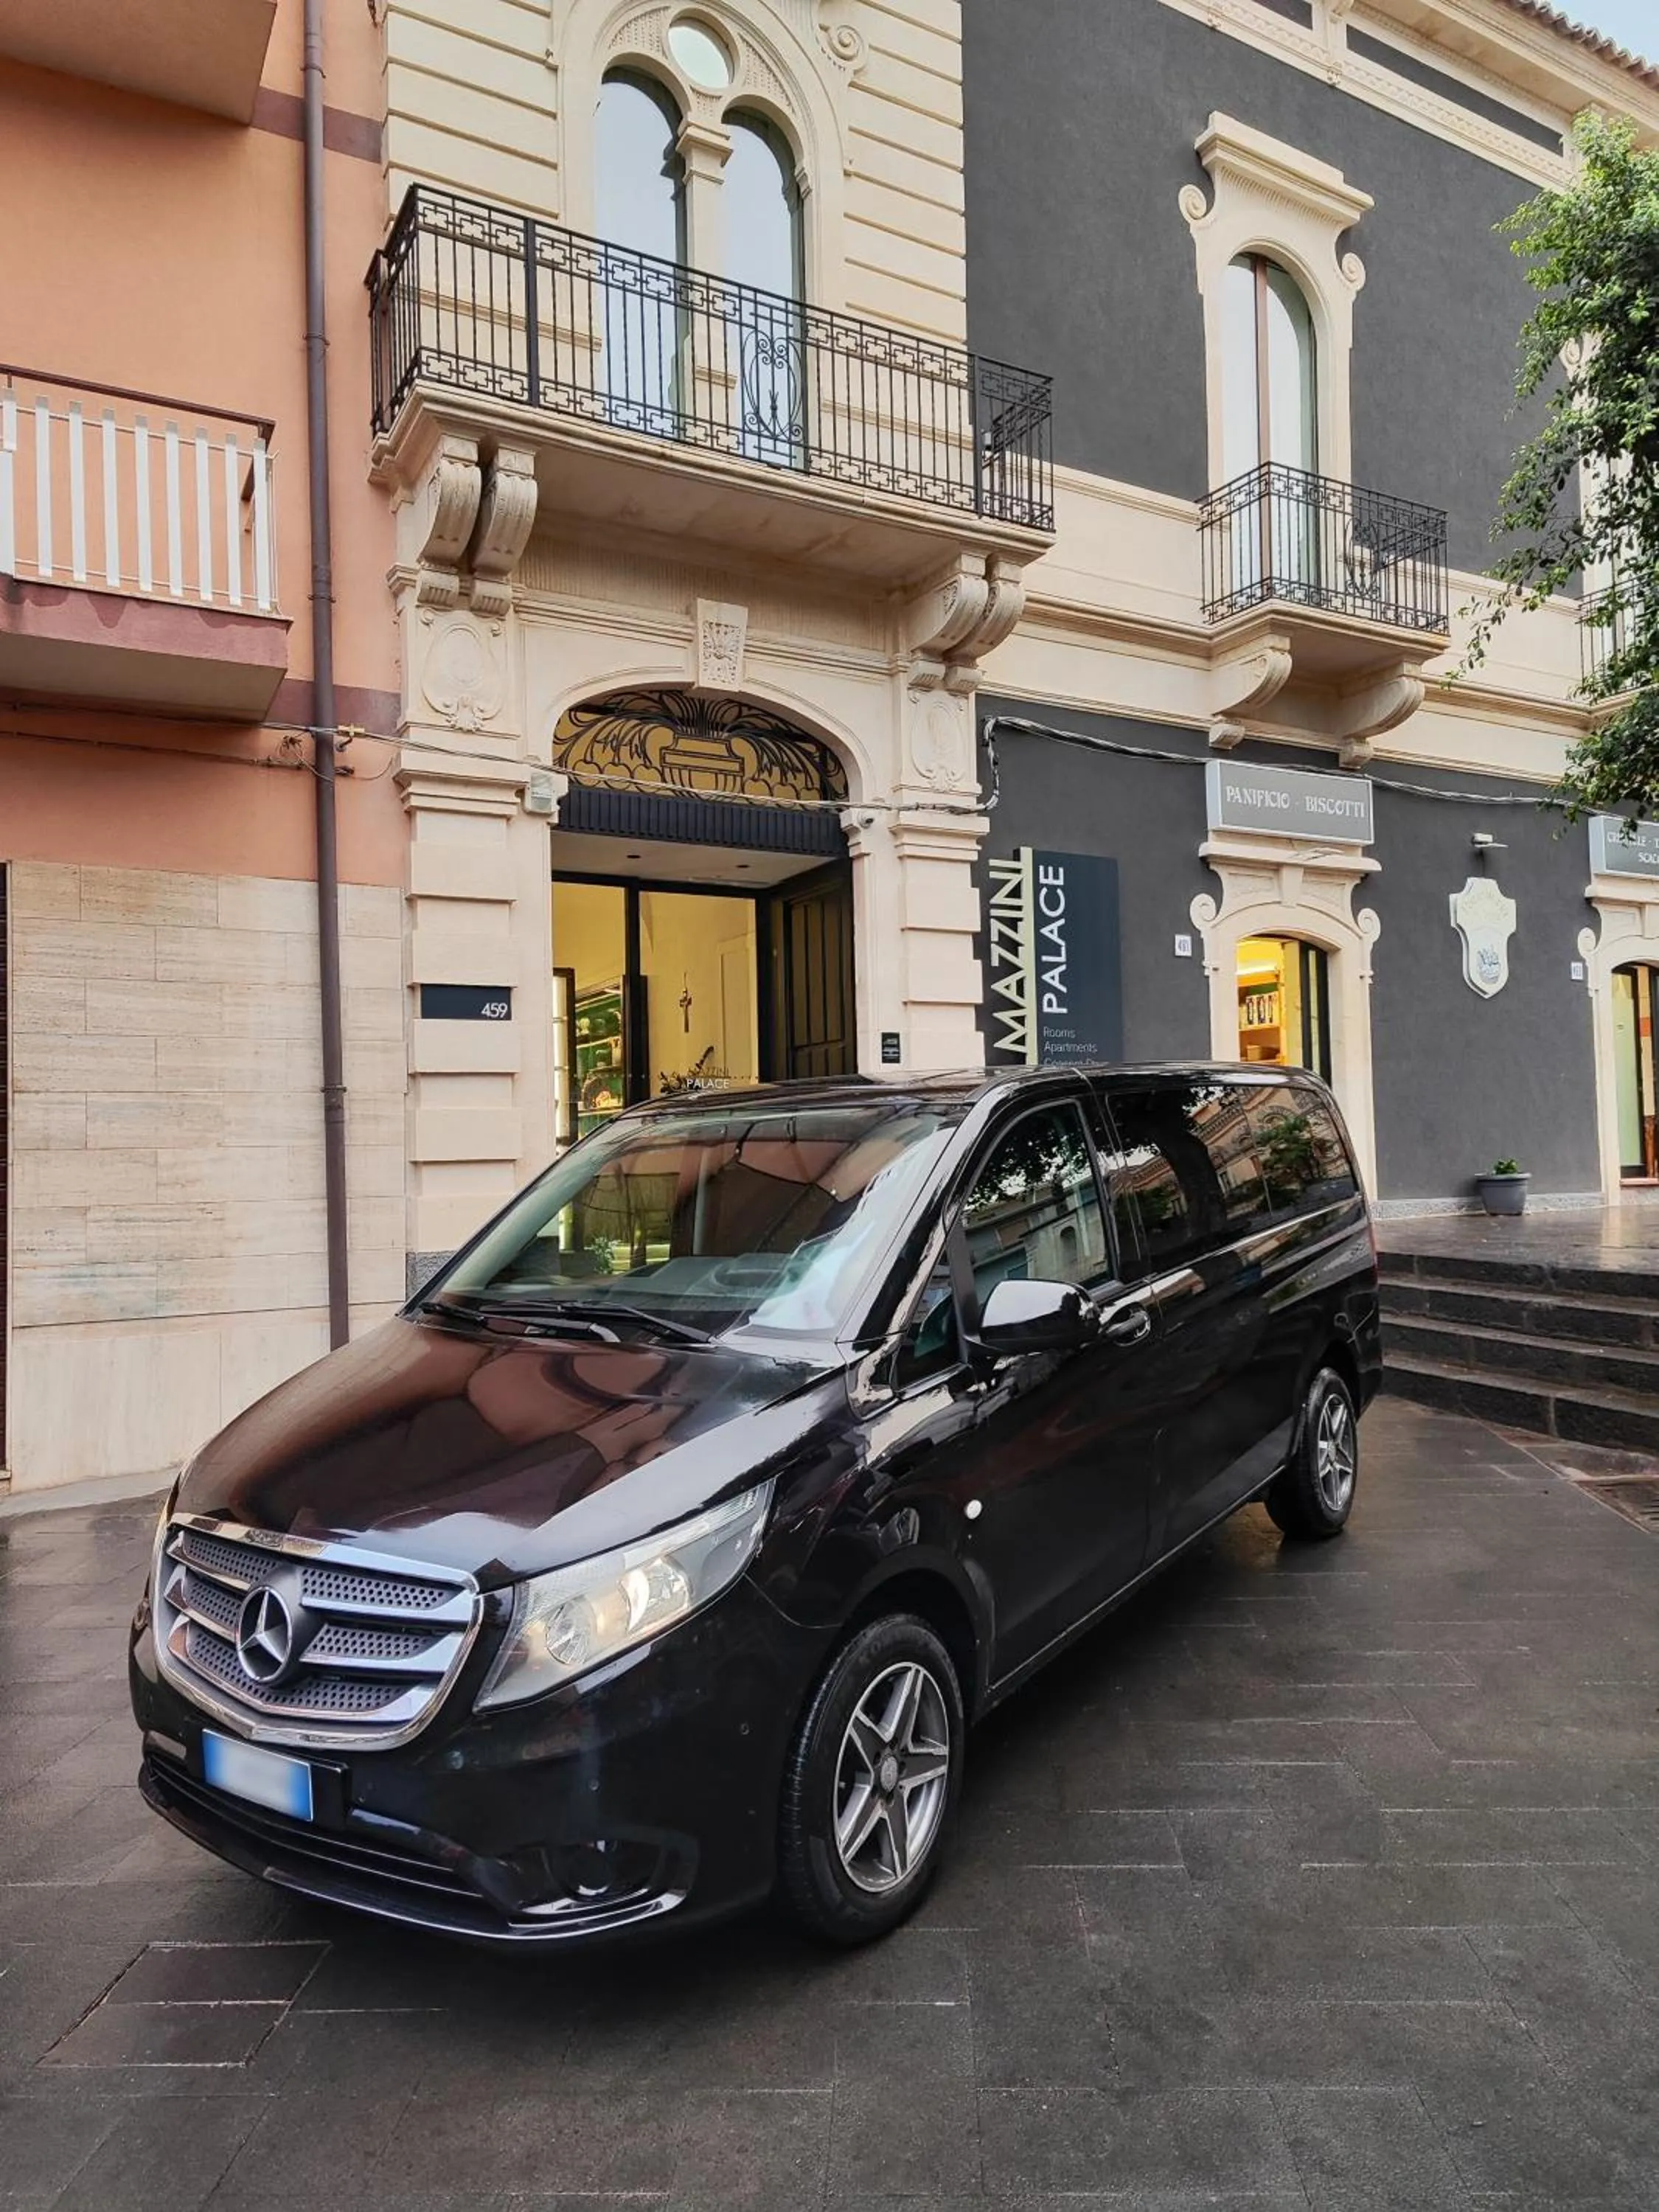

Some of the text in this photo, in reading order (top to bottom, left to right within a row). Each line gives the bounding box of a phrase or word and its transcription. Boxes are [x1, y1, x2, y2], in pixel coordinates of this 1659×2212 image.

[1225, 785, 1290, 809] PANIFICIO
[1305, 796, 1365, 818] BISCOTTI
[1039, 865, 1068, 1014] PALACE
[989, 856, 1029, 1057] MAZZINI
[481, 1002, 508, 1018] 459
[1043, 1026, 1077, 1039] Rooms
[686, 1078, 730, 1089] PALACE
